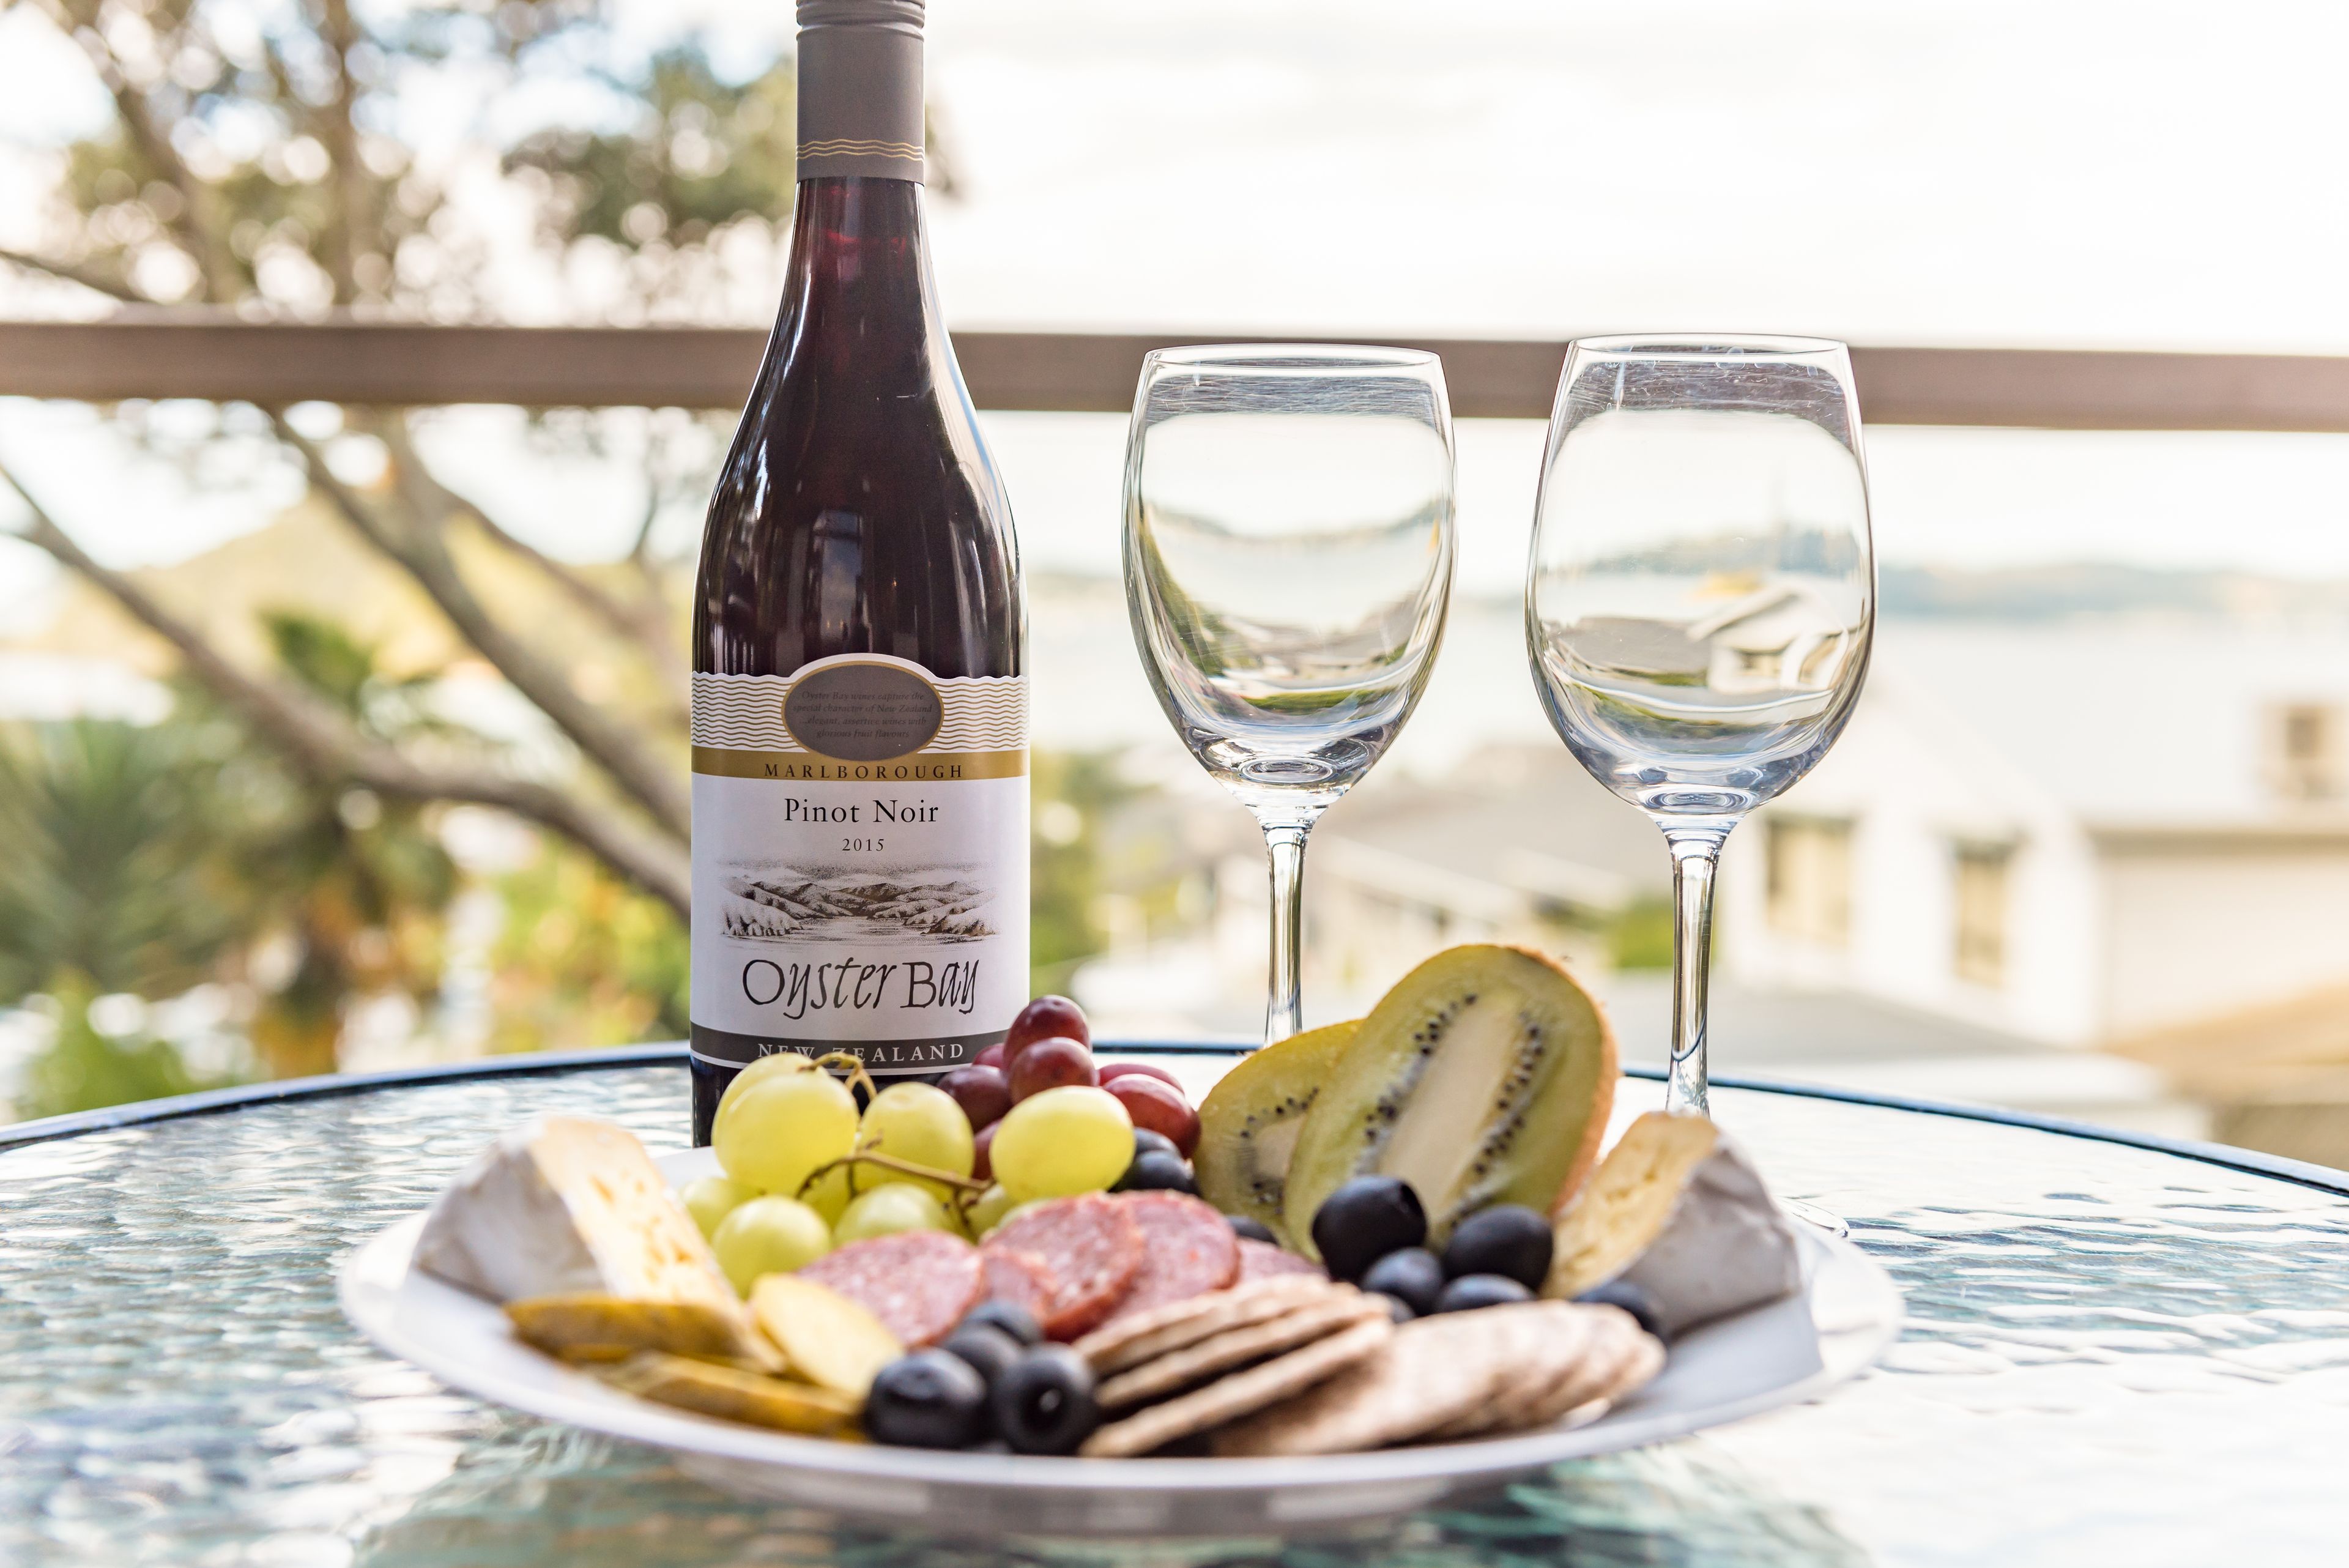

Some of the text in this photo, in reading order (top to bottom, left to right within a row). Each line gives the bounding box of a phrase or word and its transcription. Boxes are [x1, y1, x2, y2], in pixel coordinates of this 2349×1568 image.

[802, 691, 829, 700] Oyster
[833, 691, 848, 700] Bay
[877, 693, 910, 702] capture
[911, 691, 925, 700] the
[793, 703, 933, 714] special character of New Zealand
[908, 716, 927, 726] with
[816, 728, 910, 739] glorious fruit flavours
[765, 764, 962, 779] MARLBOROUGH
[784, 798, 938, 823] Pinot Noir
[842, 838, 885, 852] 2015
[742, 957, 979, 1020] Oyster Bay
